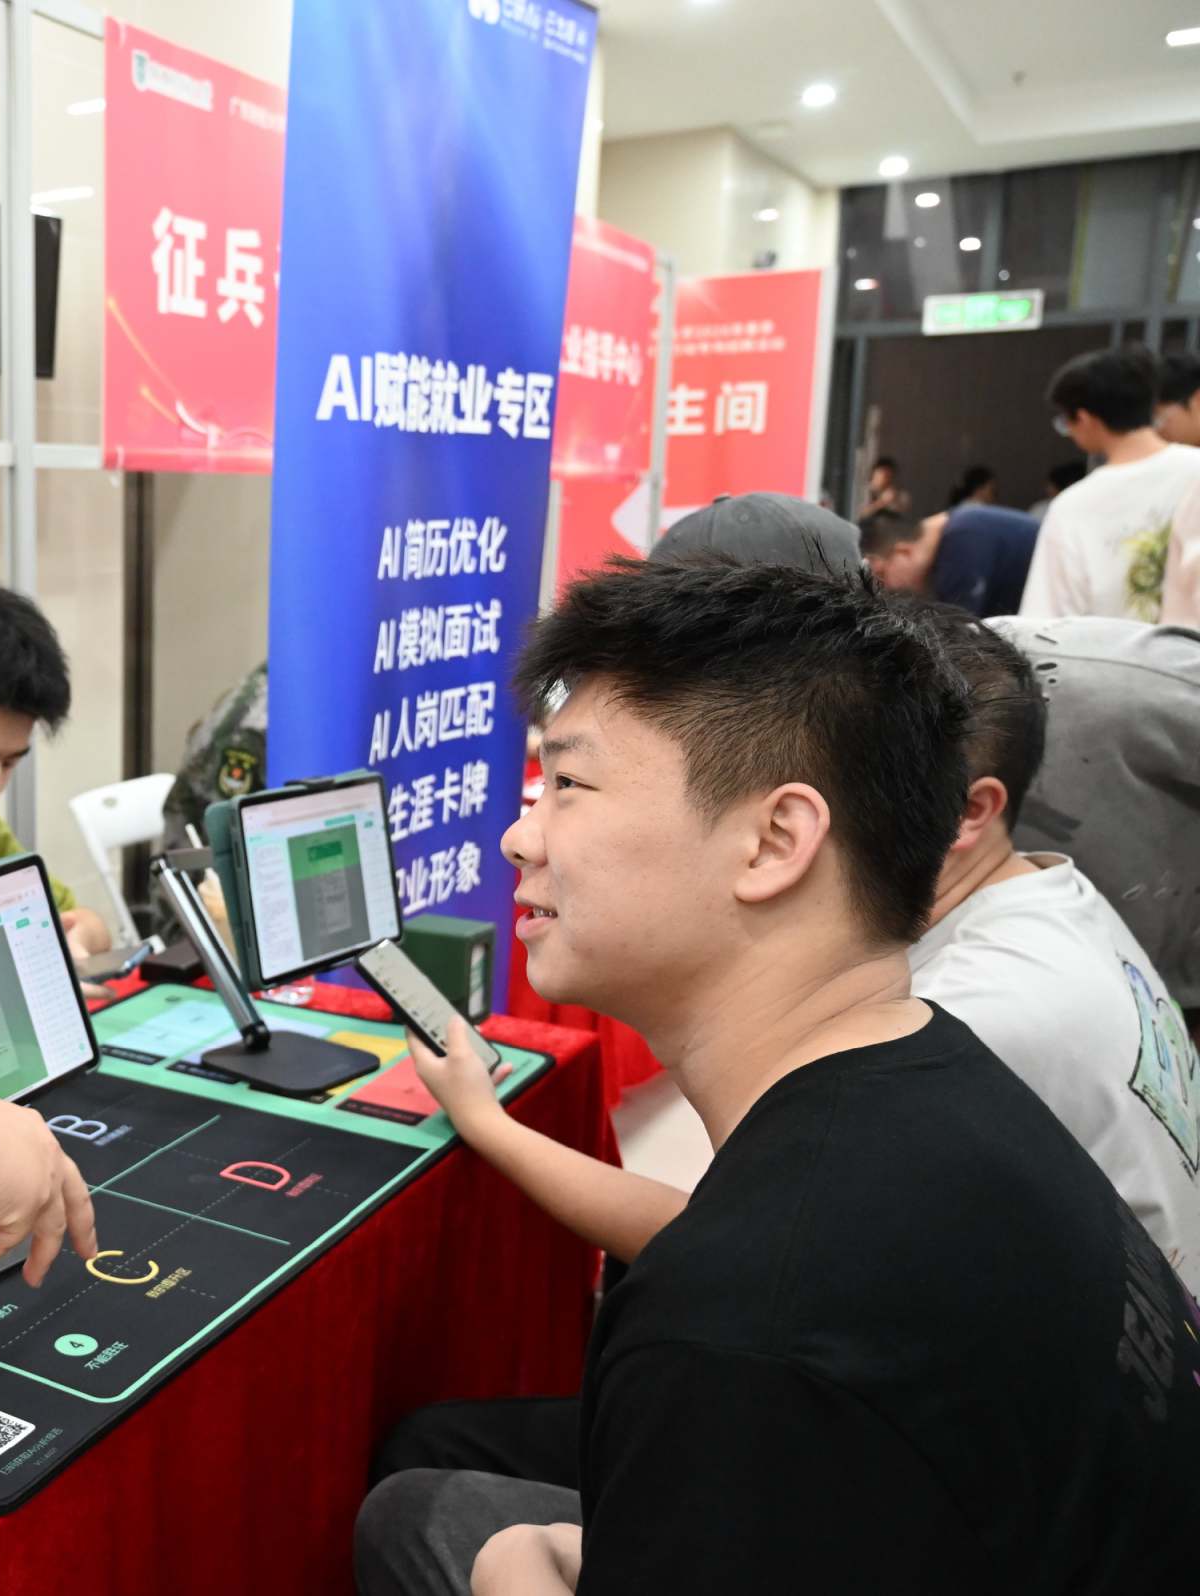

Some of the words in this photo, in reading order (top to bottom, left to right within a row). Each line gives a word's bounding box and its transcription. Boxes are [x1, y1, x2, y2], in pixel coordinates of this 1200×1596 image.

[151, 205, 281, 328] 征兵
[315, 351, 554, 440] AI赋能就业专区
[377, 516, 508, 581] AI简历优化
[373, 598, 502, 674] AI模拟面试
[368, 680, 496, 766] AI人岗匹配
[387, 759, 489, 842] 生涯卡牌
[395, 841, 482, 916] 业形象
[47, 1113, 108, 1141] B
[219, 1160, 291, 1192] D
[85, 1249, 160, 1285] C
